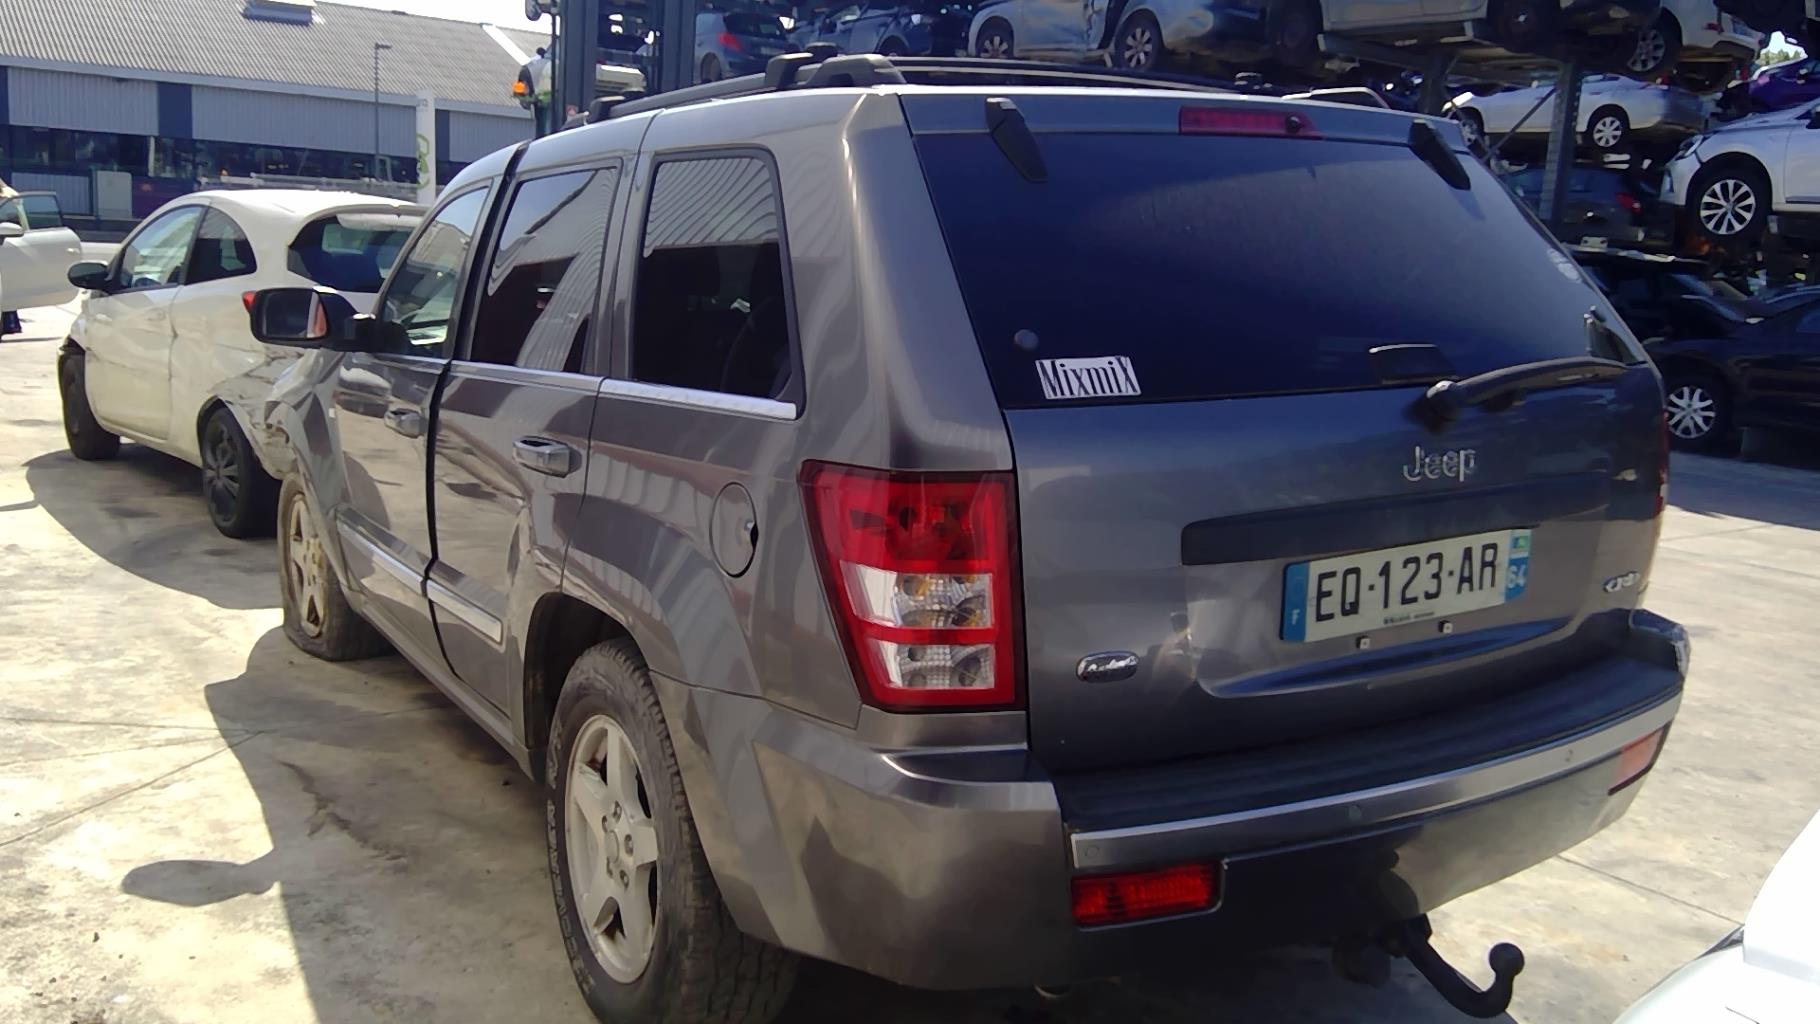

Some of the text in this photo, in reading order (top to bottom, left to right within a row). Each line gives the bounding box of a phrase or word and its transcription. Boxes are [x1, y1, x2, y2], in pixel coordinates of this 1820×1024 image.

[1403, 446, 1476, 481] Jeep
[1507, 564, 1527, 588] 64
[1291, 608, 1301, 626] F
